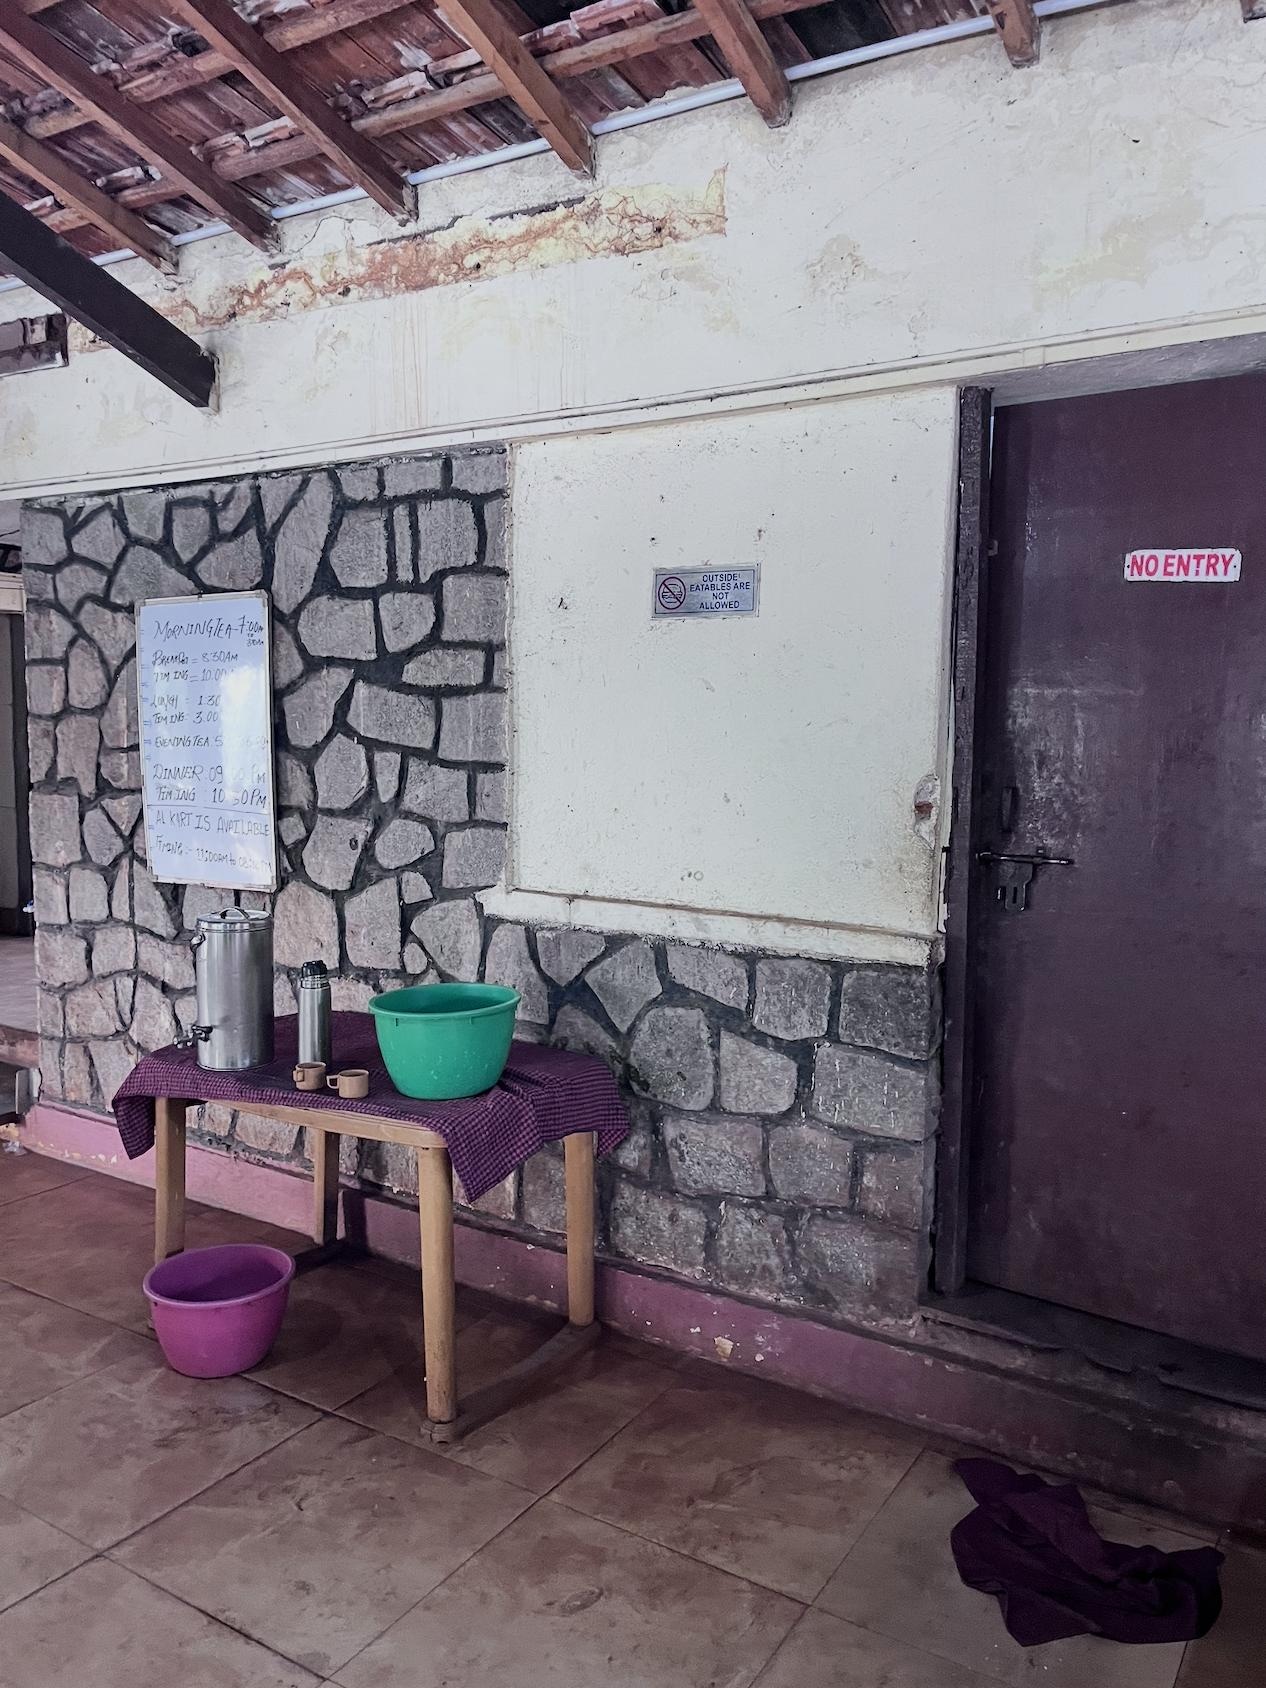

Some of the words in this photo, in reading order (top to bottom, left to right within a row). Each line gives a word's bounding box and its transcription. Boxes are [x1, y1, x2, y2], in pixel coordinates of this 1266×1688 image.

[1130, 554, 1159, 576] NO
[1163, 553, 1234, 576] ENTRY
[702, 573, 738, 582] OUTSIDE
[690, 583, 731, 592] EATABLES
[733, 582, 750, 590] ARE
[712, 592, 729, 600] NOT
[700, 601, 739, 609] ALLOWED
[153, 764, 203, 781] DINNER
[195, 815, 211, 831] IS
[217, 817, 269, 836] AVAILABLE
